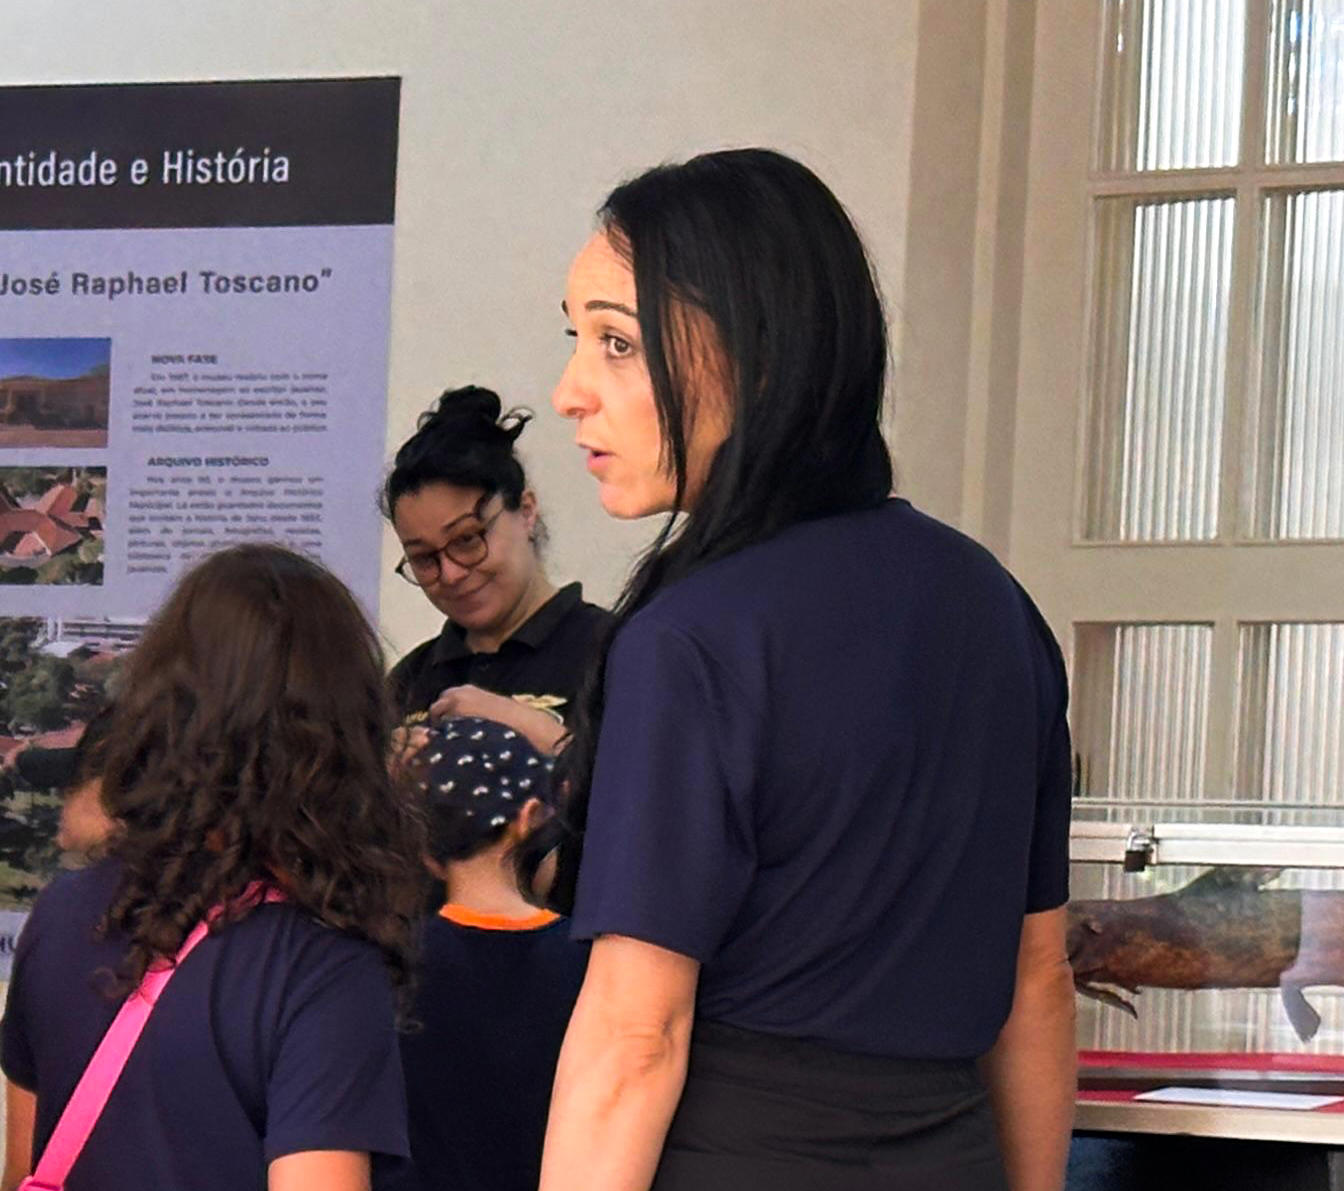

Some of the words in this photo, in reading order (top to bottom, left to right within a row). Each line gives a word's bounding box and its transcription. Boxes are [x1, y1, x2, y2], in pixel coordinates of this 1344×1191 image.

[130, 157, 150, 185] e
[162, 146, 291, 185] História
[71, 270, 188, 301] Raphael
[199, 268, 332, 295] Toscano"
[147, 457, 202, 468] ARQUIVO
